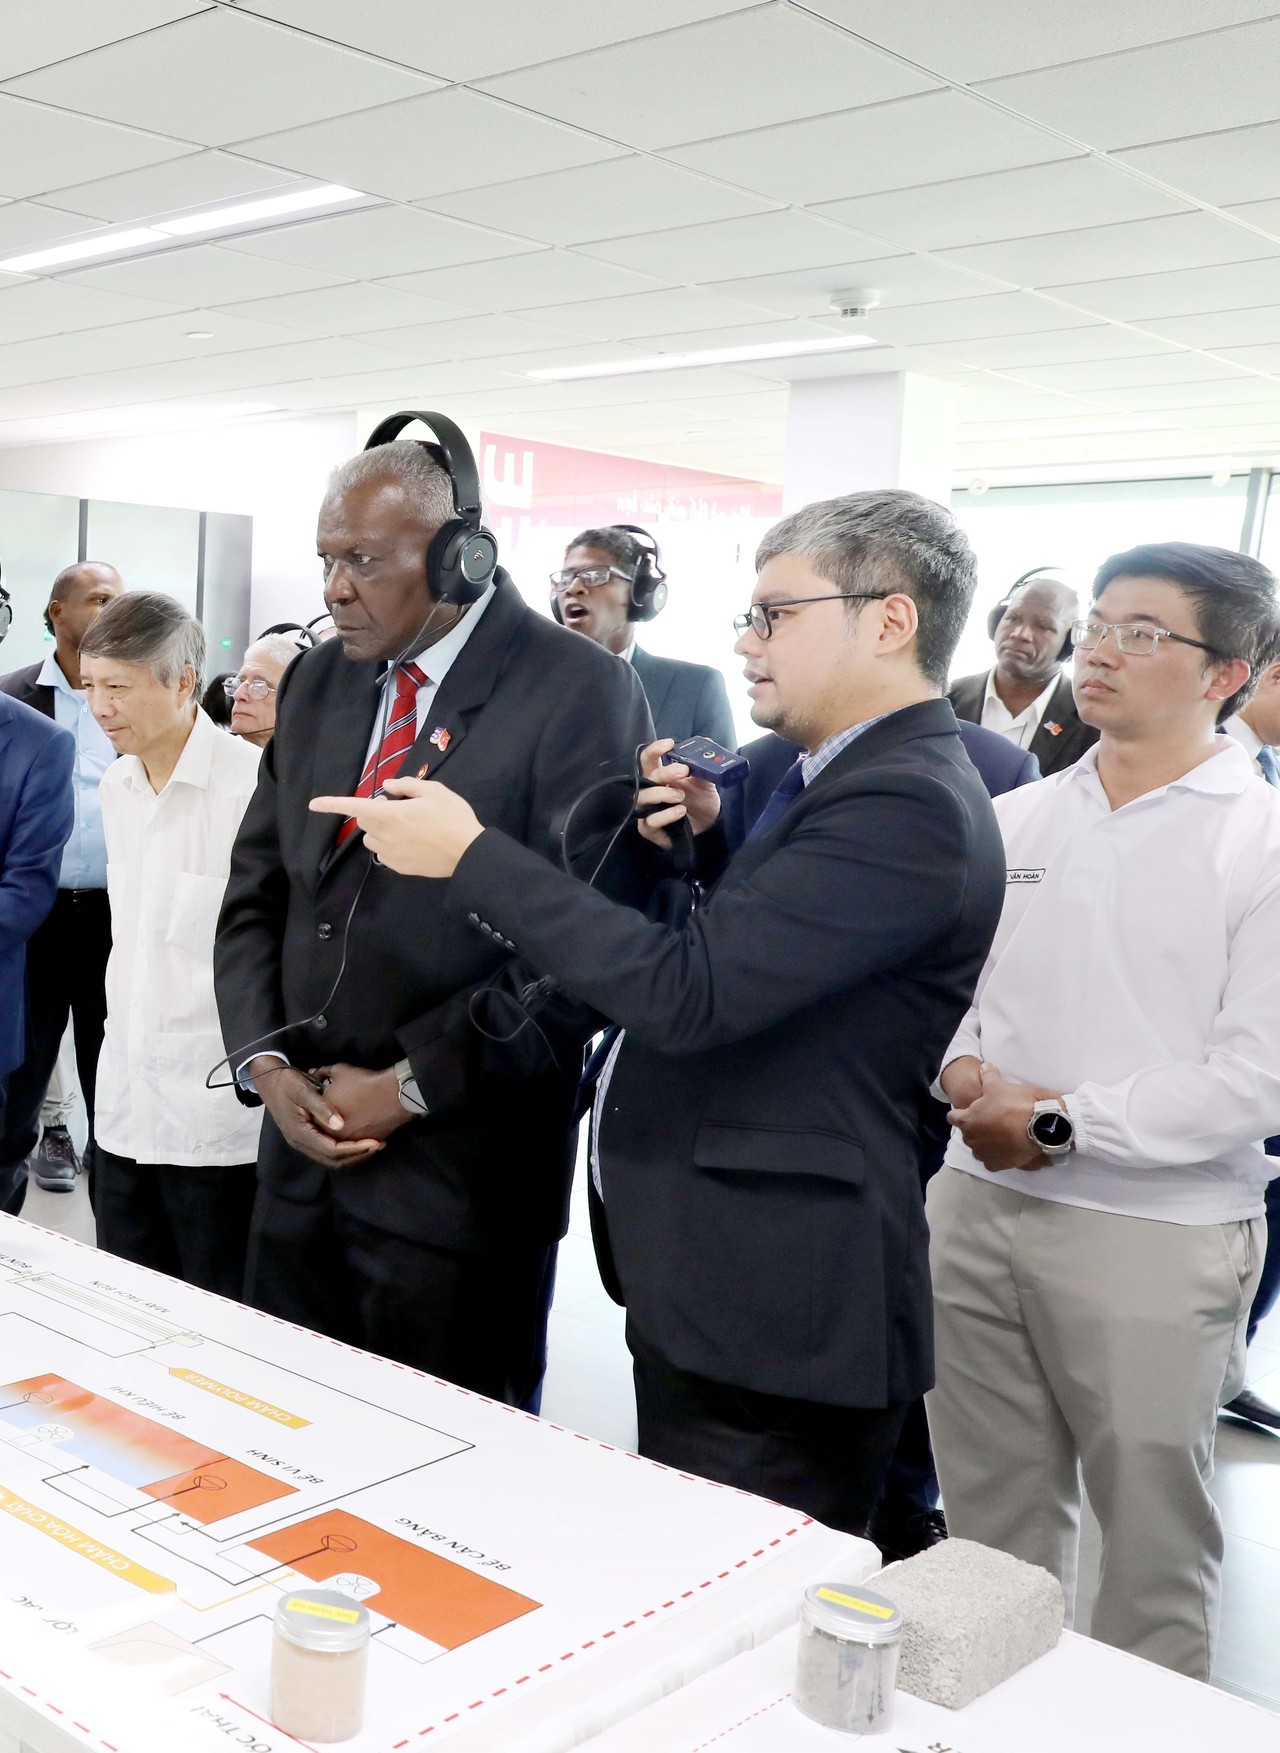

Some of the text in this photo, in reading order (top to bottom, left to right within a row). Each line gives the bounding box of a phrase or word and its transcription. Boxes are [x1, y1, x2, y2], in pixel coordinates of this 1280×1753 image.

[185, 1373, 250, 1404] POLYMER
[246, 1448, 282, 1467] SINH
[281, 1465, 301, 1475] VI
[445, 1541, 486, 1559] CÂN
